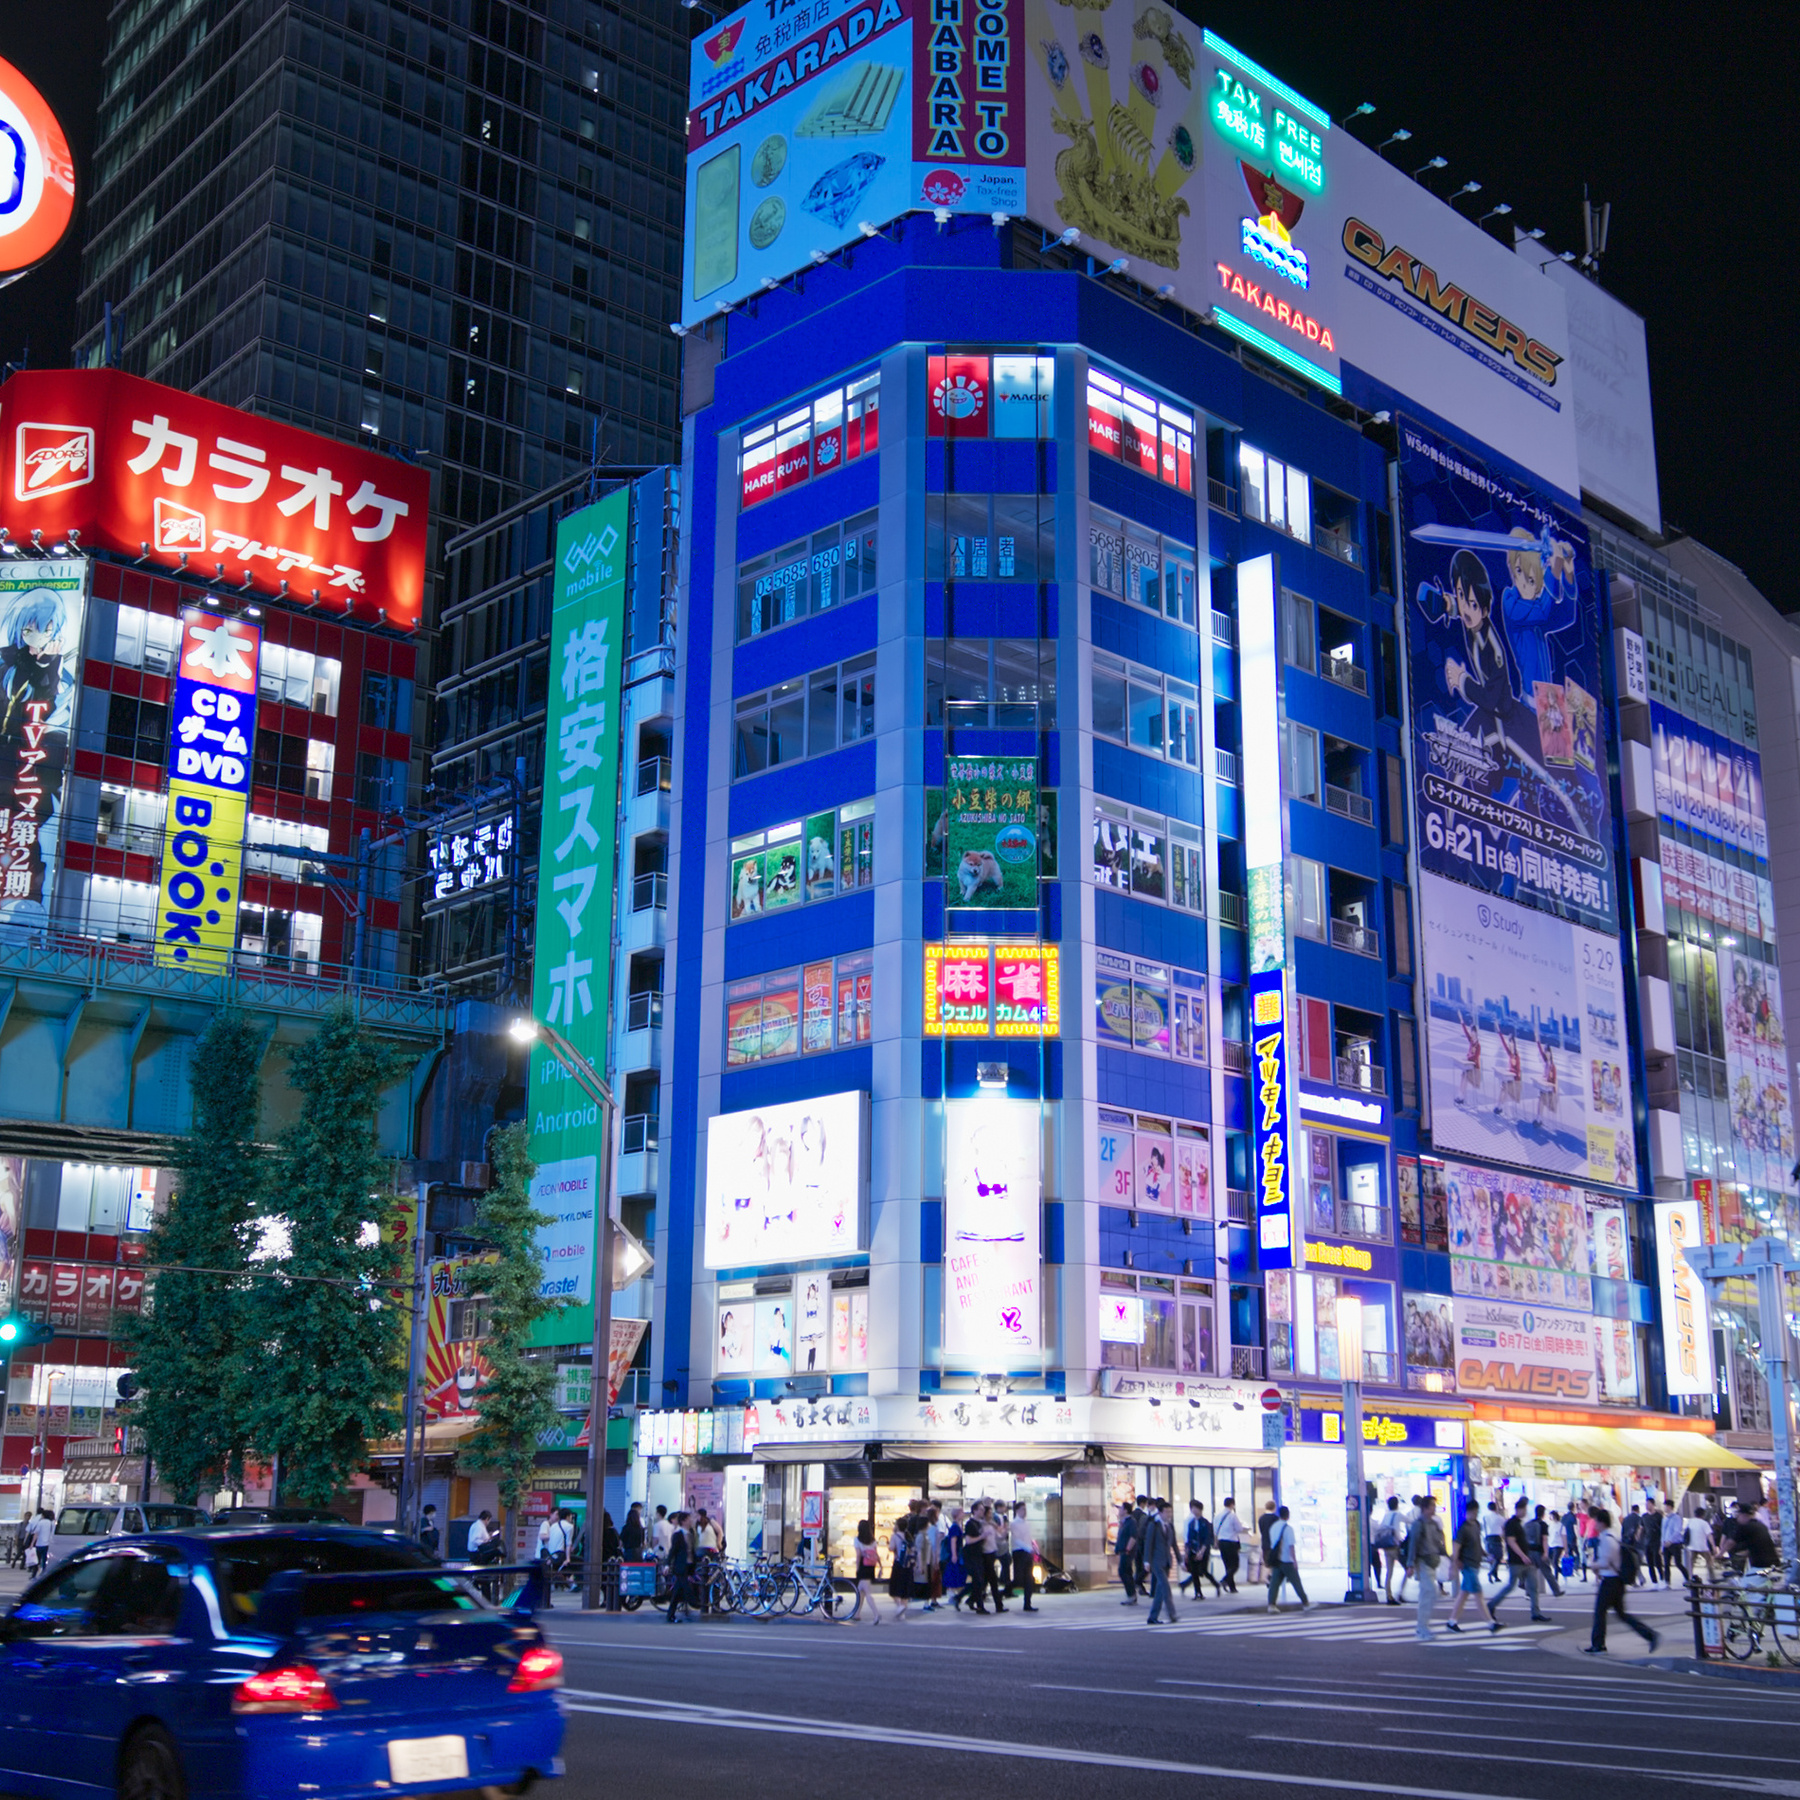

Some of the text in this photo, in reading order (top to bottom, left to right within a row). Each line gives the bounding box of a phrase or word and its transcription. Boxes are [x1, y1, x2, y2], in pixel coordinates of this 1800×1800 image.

[700, 0, 903, 136] TAKARADA
[1216, 68, 1322, 158] TAX FREE
[975, 101, 1009, 158] TO
[976, 185, 1018, 197] Tax-free
[980, 173, 1017, 185] Japan.
[990, 197, 1018, 208] Shop
[1215, 262, 1336, 353] TAKARADA
[1342, 217, 1564, 387] GAMERS
[1009, 392, 1050, 402] MAGIC
[1088, 417, 1156, 460] HARE RUYA
[127, 414, 409, 542] カラオケ
[744, 455, 808, 495] HARE RUYA
[1125, 541, 1160, 571] 6805
[0, 580, 79, 591] 5th Anniversary
[566, 560, 613, 597] mobile
[187, 625, 254, 680] 本
[192, 687, 241, 721] CD
[178, 715, 248, 755] ゲーム
[177, 747, 246, 784] DVD
[3, 702, 48, 899] TVアニメ第2期
[951, 786, 1032, 813] 小豆柴の郷
[546, 617, 610, 1027] 格安スマホ
[163, 795, 213, 946] BOOK
[1493, 912, 1524, 940] Study
[1582, 943, 1614, 972] 5.29
[936, 960, 1042, 1000] 麻雀
[534, 1103, 598, 1135] Android
[1256, 1032, 1284, 1206] マツモトキヨシ
[1101, 1136, 1116, 1163] 2F
[1115, 1170, 1131, 1195] 3F
[577, 1209, 593, 1221] ONE
[552, 1243, 586, 1259] mobile
[950, 1253, 980, 1273] CAFE
[1304, 1241, 1372, 1271] ax Free Shop
[22, 1269, 143, 1301] カラオケ
[956, 1273, 980, 1291] AND
[1667, 1209, 1699, 1384] GAMERS
[21, 1310, 44, 1323] 3F
[50, 1312, 77, 1326] 受付
[1458, 1359, 1594, 1398] GAMERS
[793, 1401, 854, 1428] 富士そば
[858, 1407, 870, 1417] 24
[1055, 1407, 1073, 1418] 24
